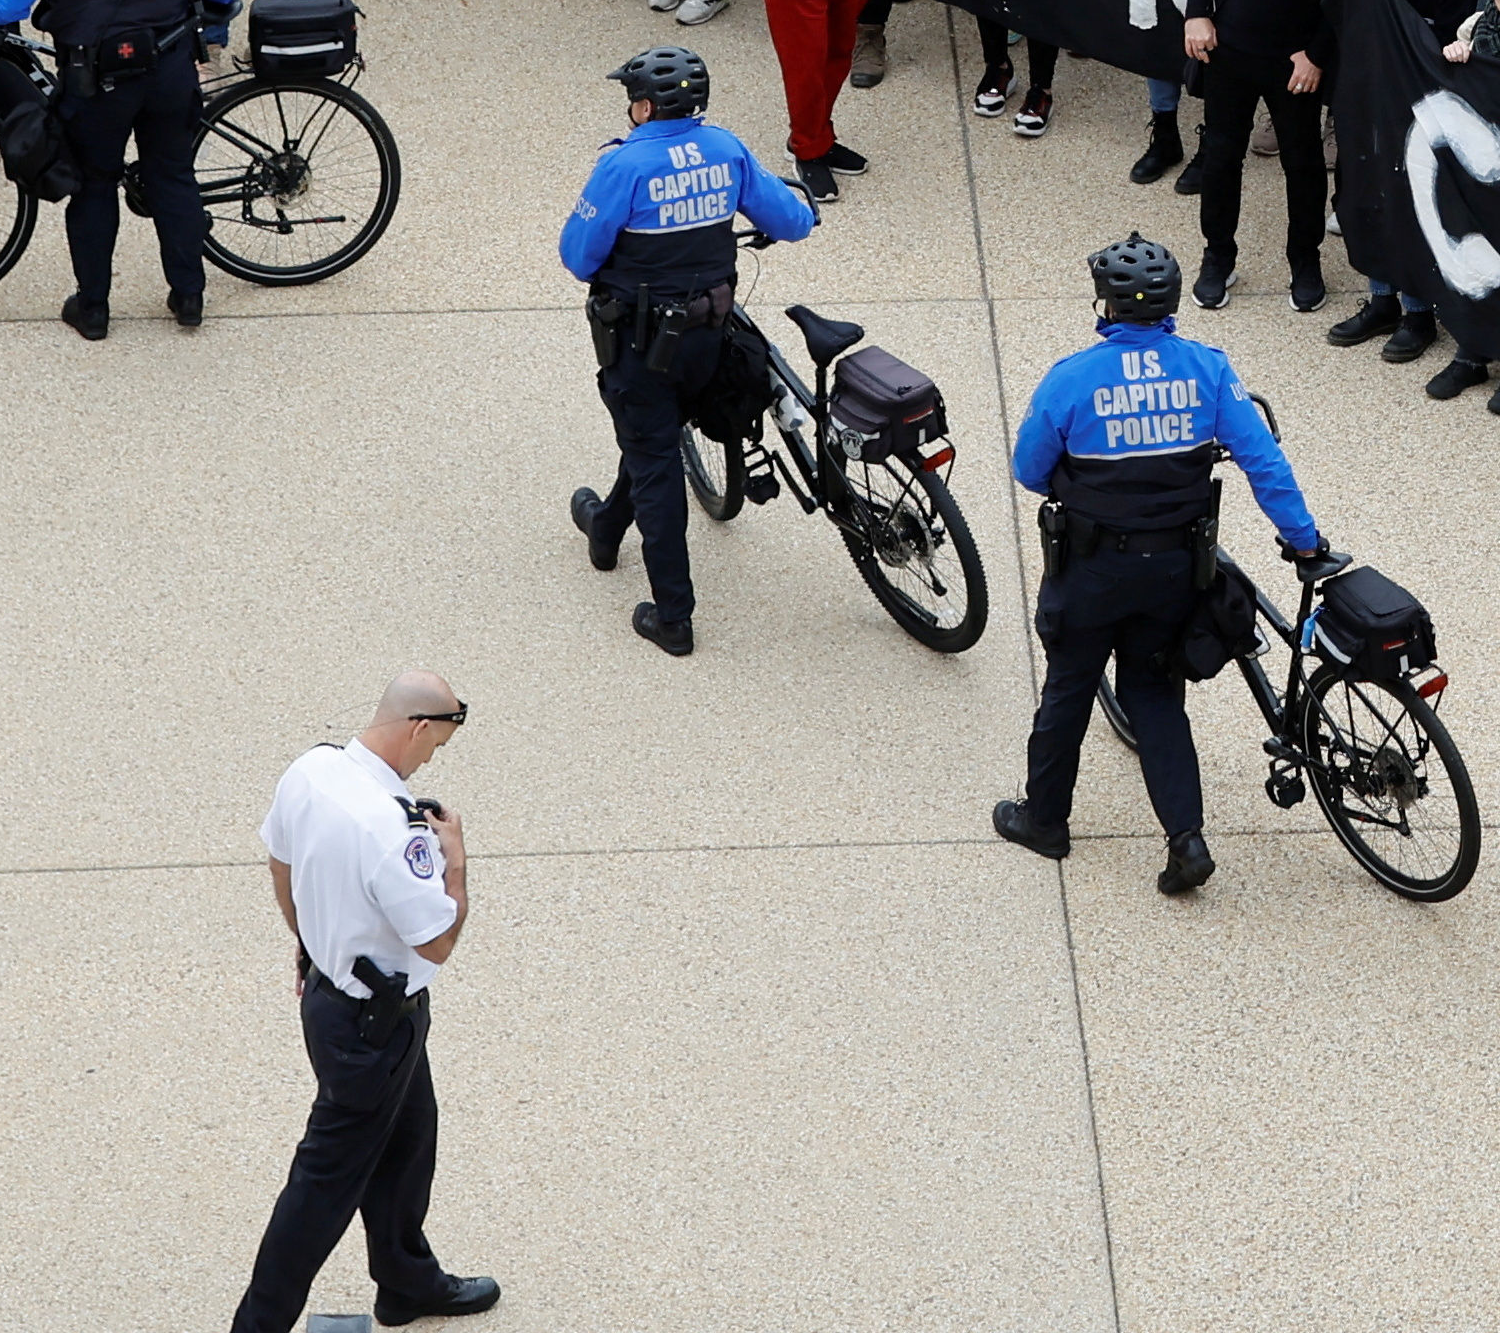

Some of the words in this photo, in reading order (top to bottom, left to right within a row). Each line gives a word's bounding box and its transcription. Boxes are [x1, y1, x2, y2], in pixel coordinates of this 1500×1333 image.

[668, 142, 706, 169] U.S.
[648, 163, 732, 203] CAPITOL
[659, 192, 728, 226] POLICE
